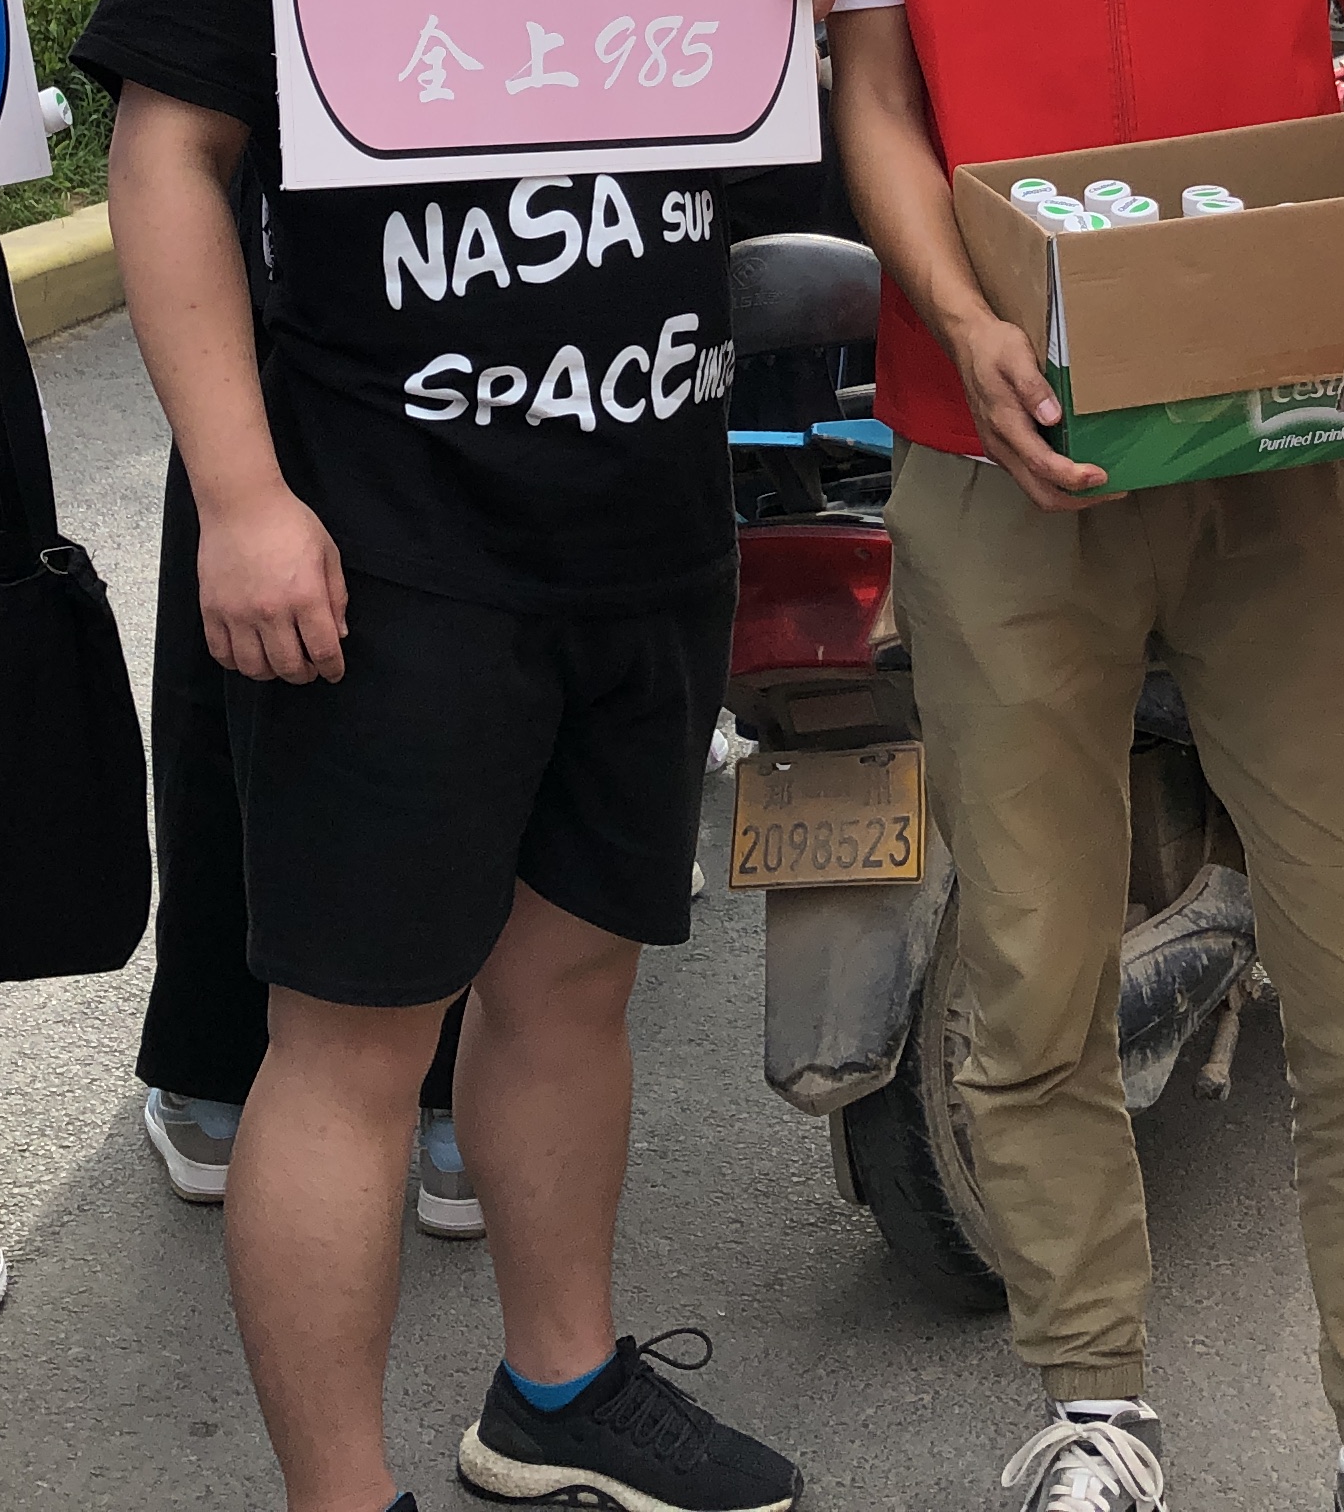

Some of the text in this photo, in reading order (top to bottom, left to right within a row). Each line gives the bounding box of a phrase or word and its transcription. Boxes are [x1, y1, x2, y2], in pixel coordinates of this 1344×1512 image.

[382, 173, 644, 310] NASA
[403, 312, 699, 432] SPACE
[1258, 433, 1312, 453] Purified
[739, 815, 911, 874] 2098523
